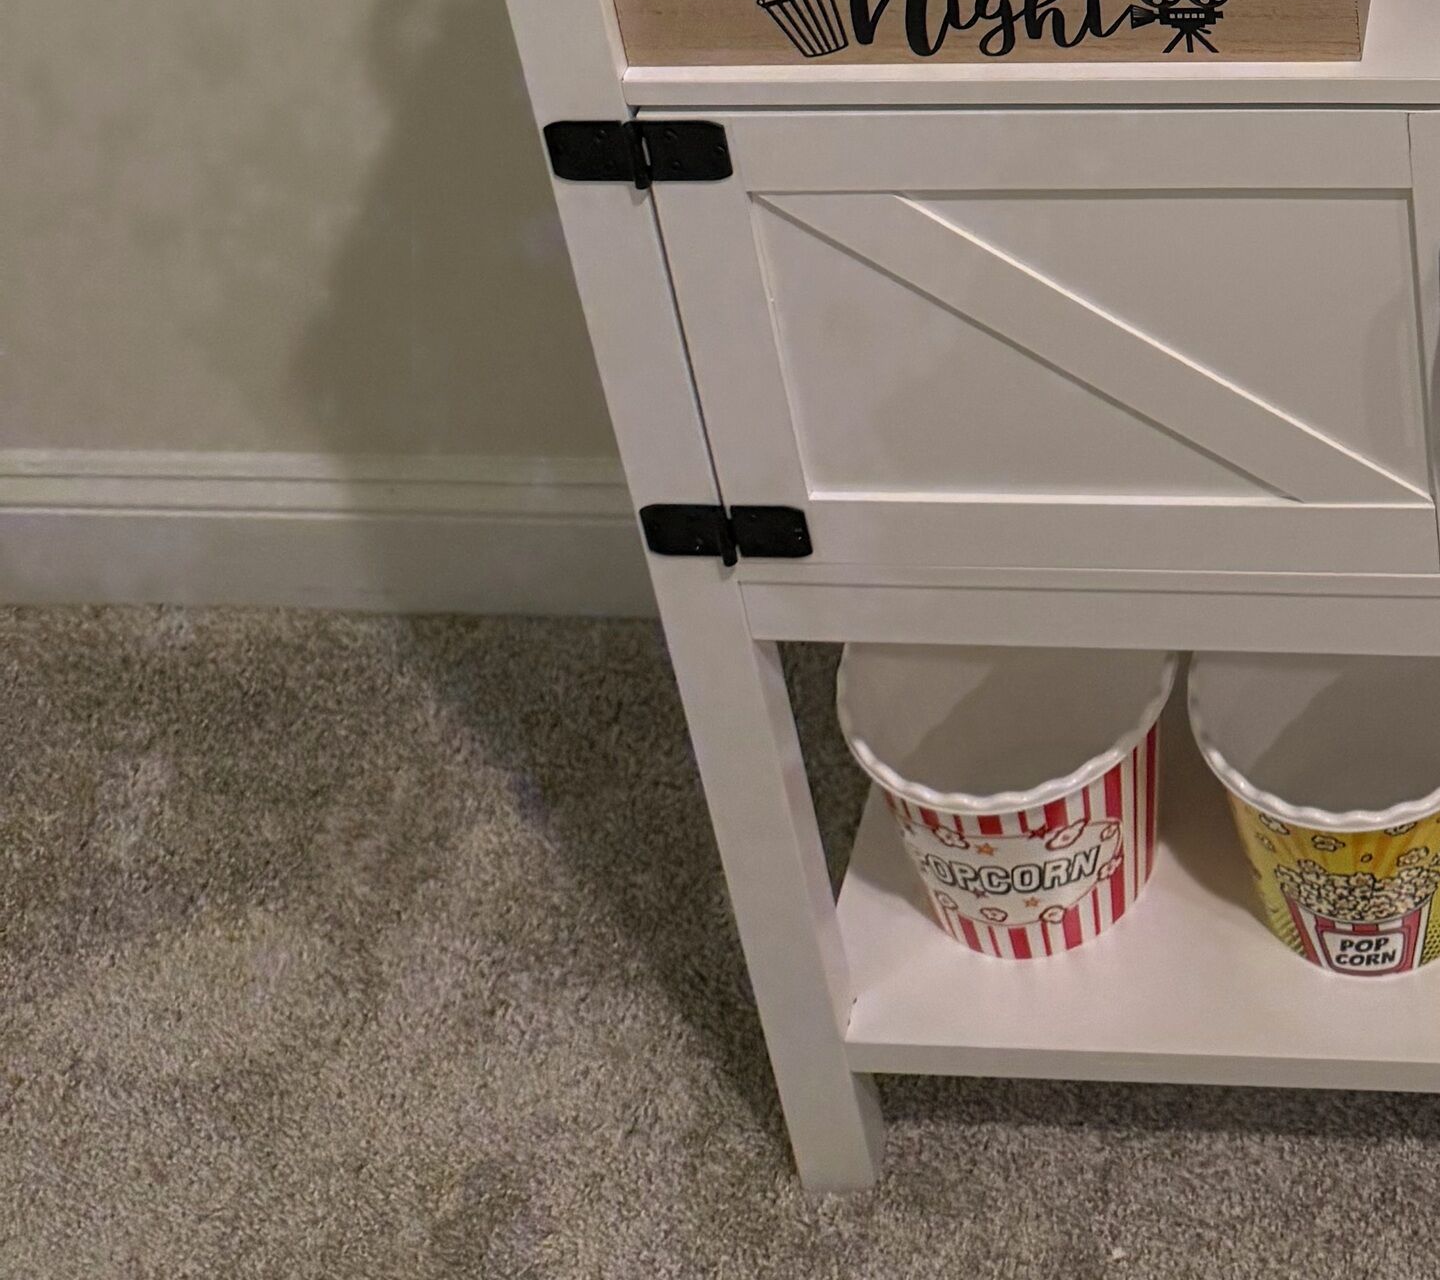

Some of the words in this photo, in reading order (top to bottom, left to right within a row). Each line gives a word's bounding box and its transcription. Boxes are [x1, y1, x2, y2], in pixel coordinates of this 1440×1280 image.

[920, 844, 1101, 895] OPCORN
[1339, 937, 1390, 953] POP
[1335, 949, 1396, 967] CORN
